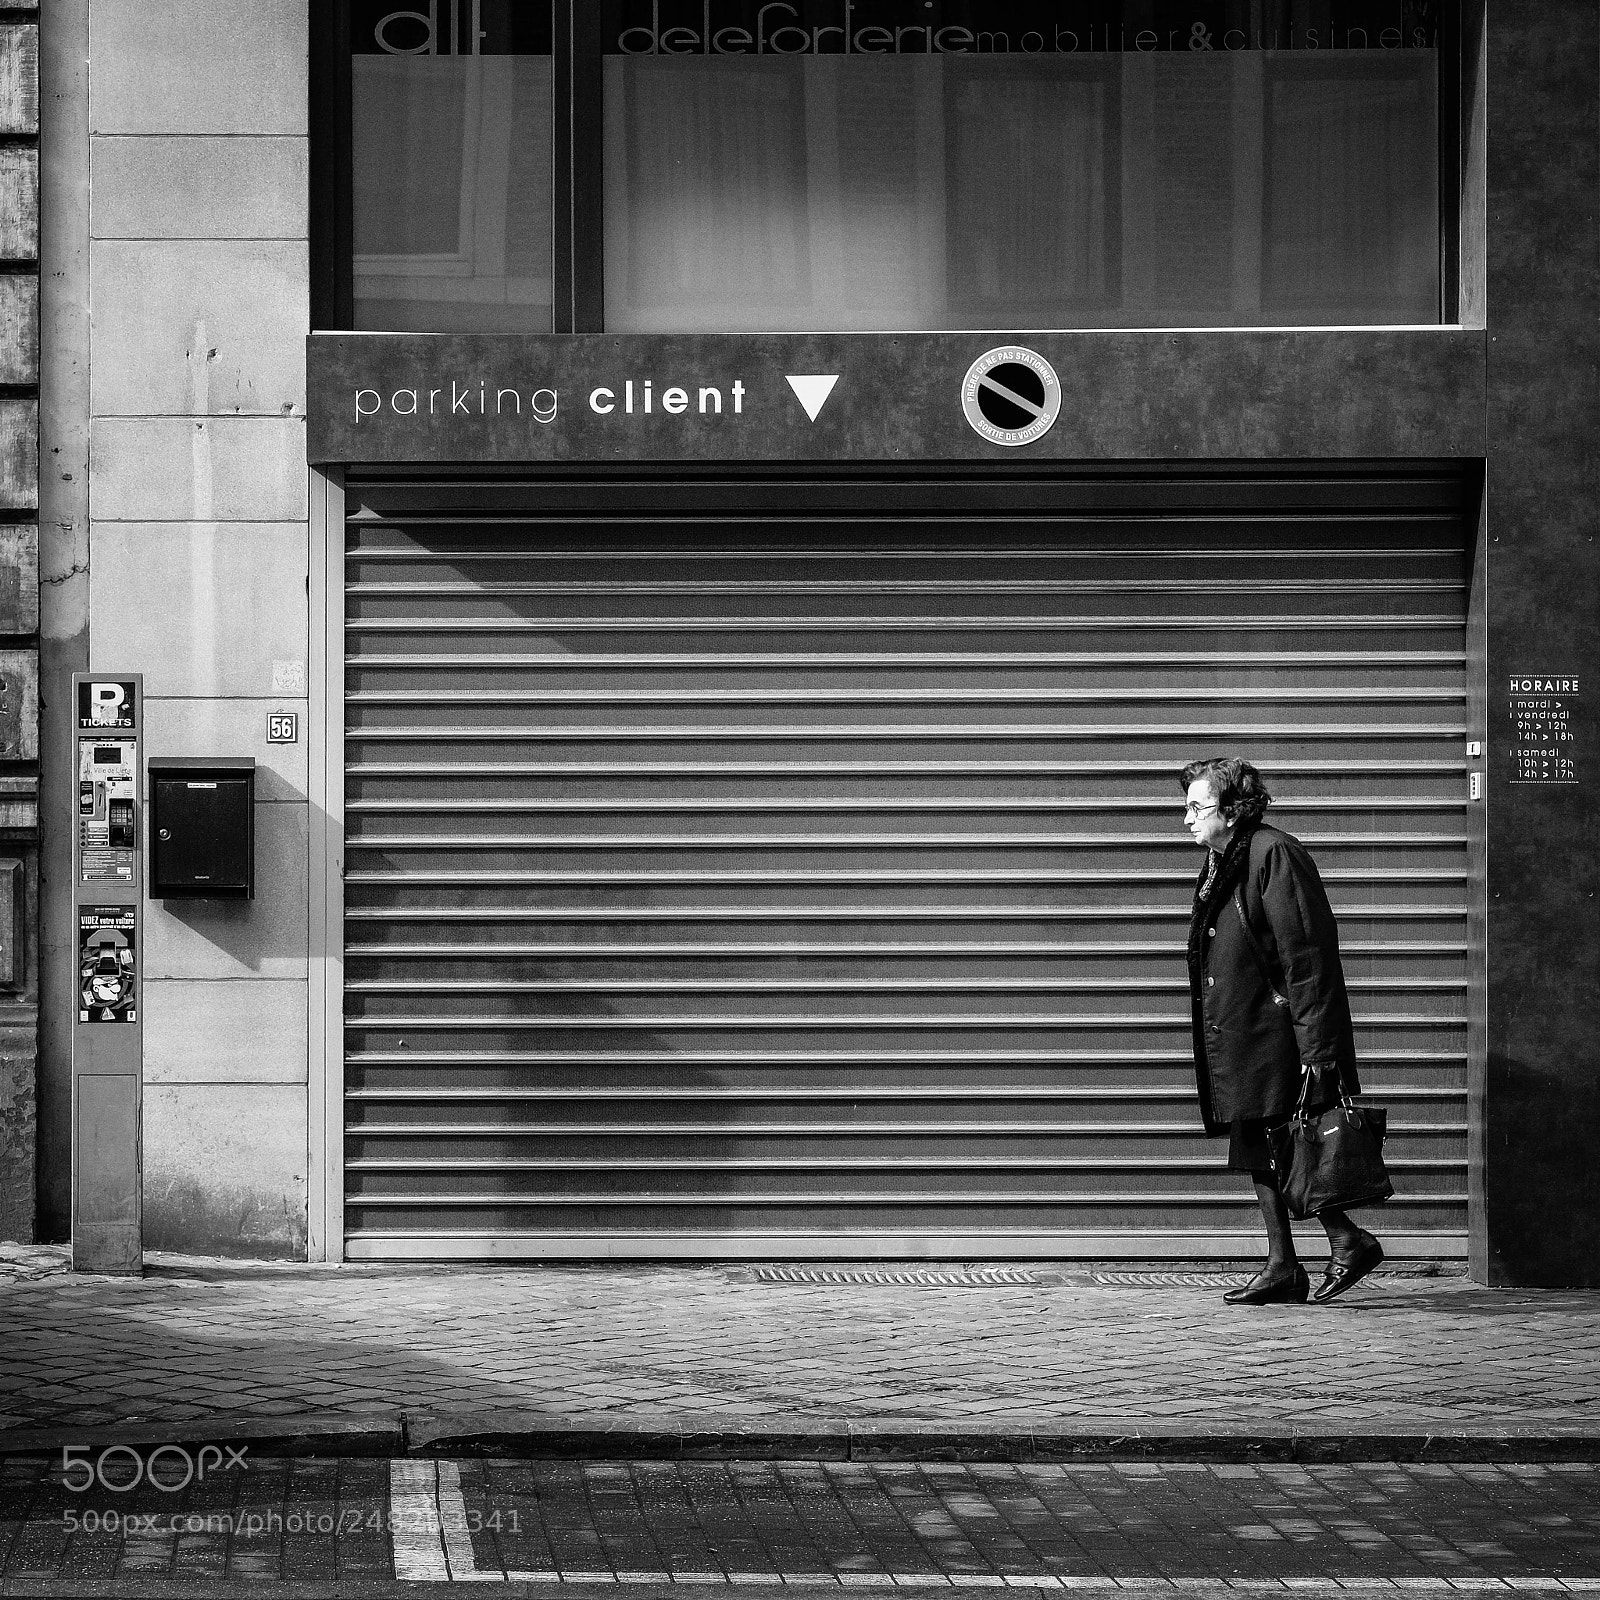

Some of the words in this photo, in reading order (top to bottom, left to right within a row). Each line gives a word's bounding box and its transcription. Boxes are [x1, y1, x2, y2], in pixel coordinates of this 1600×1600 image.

[976, 362, 988, 375] DE
[986, 355, 998, 366] NE
[997, 351, 1014, 361] PAS
[1015, 351, 1054, 386] STATIONNER
[355, 381, 559, 424] parking
[589, 380, 746, 414] client
[977, 420, 1004, 440] SORTIE
[1005, 432, 1017, 441] DE
[1017, 412, 1050, 440] VOITURES
[1510, 680, 1578, 691] HORAIRE
[91, 683, 124, 719] P
[80, 718, 132, 727] TICKETS
[271, 717, 292, 738] 56
[1518, 731, 1537, 740] 14h
[1554, 731, 1573, 740] 18h
[81, 915, 99, 925] VIDEZ
